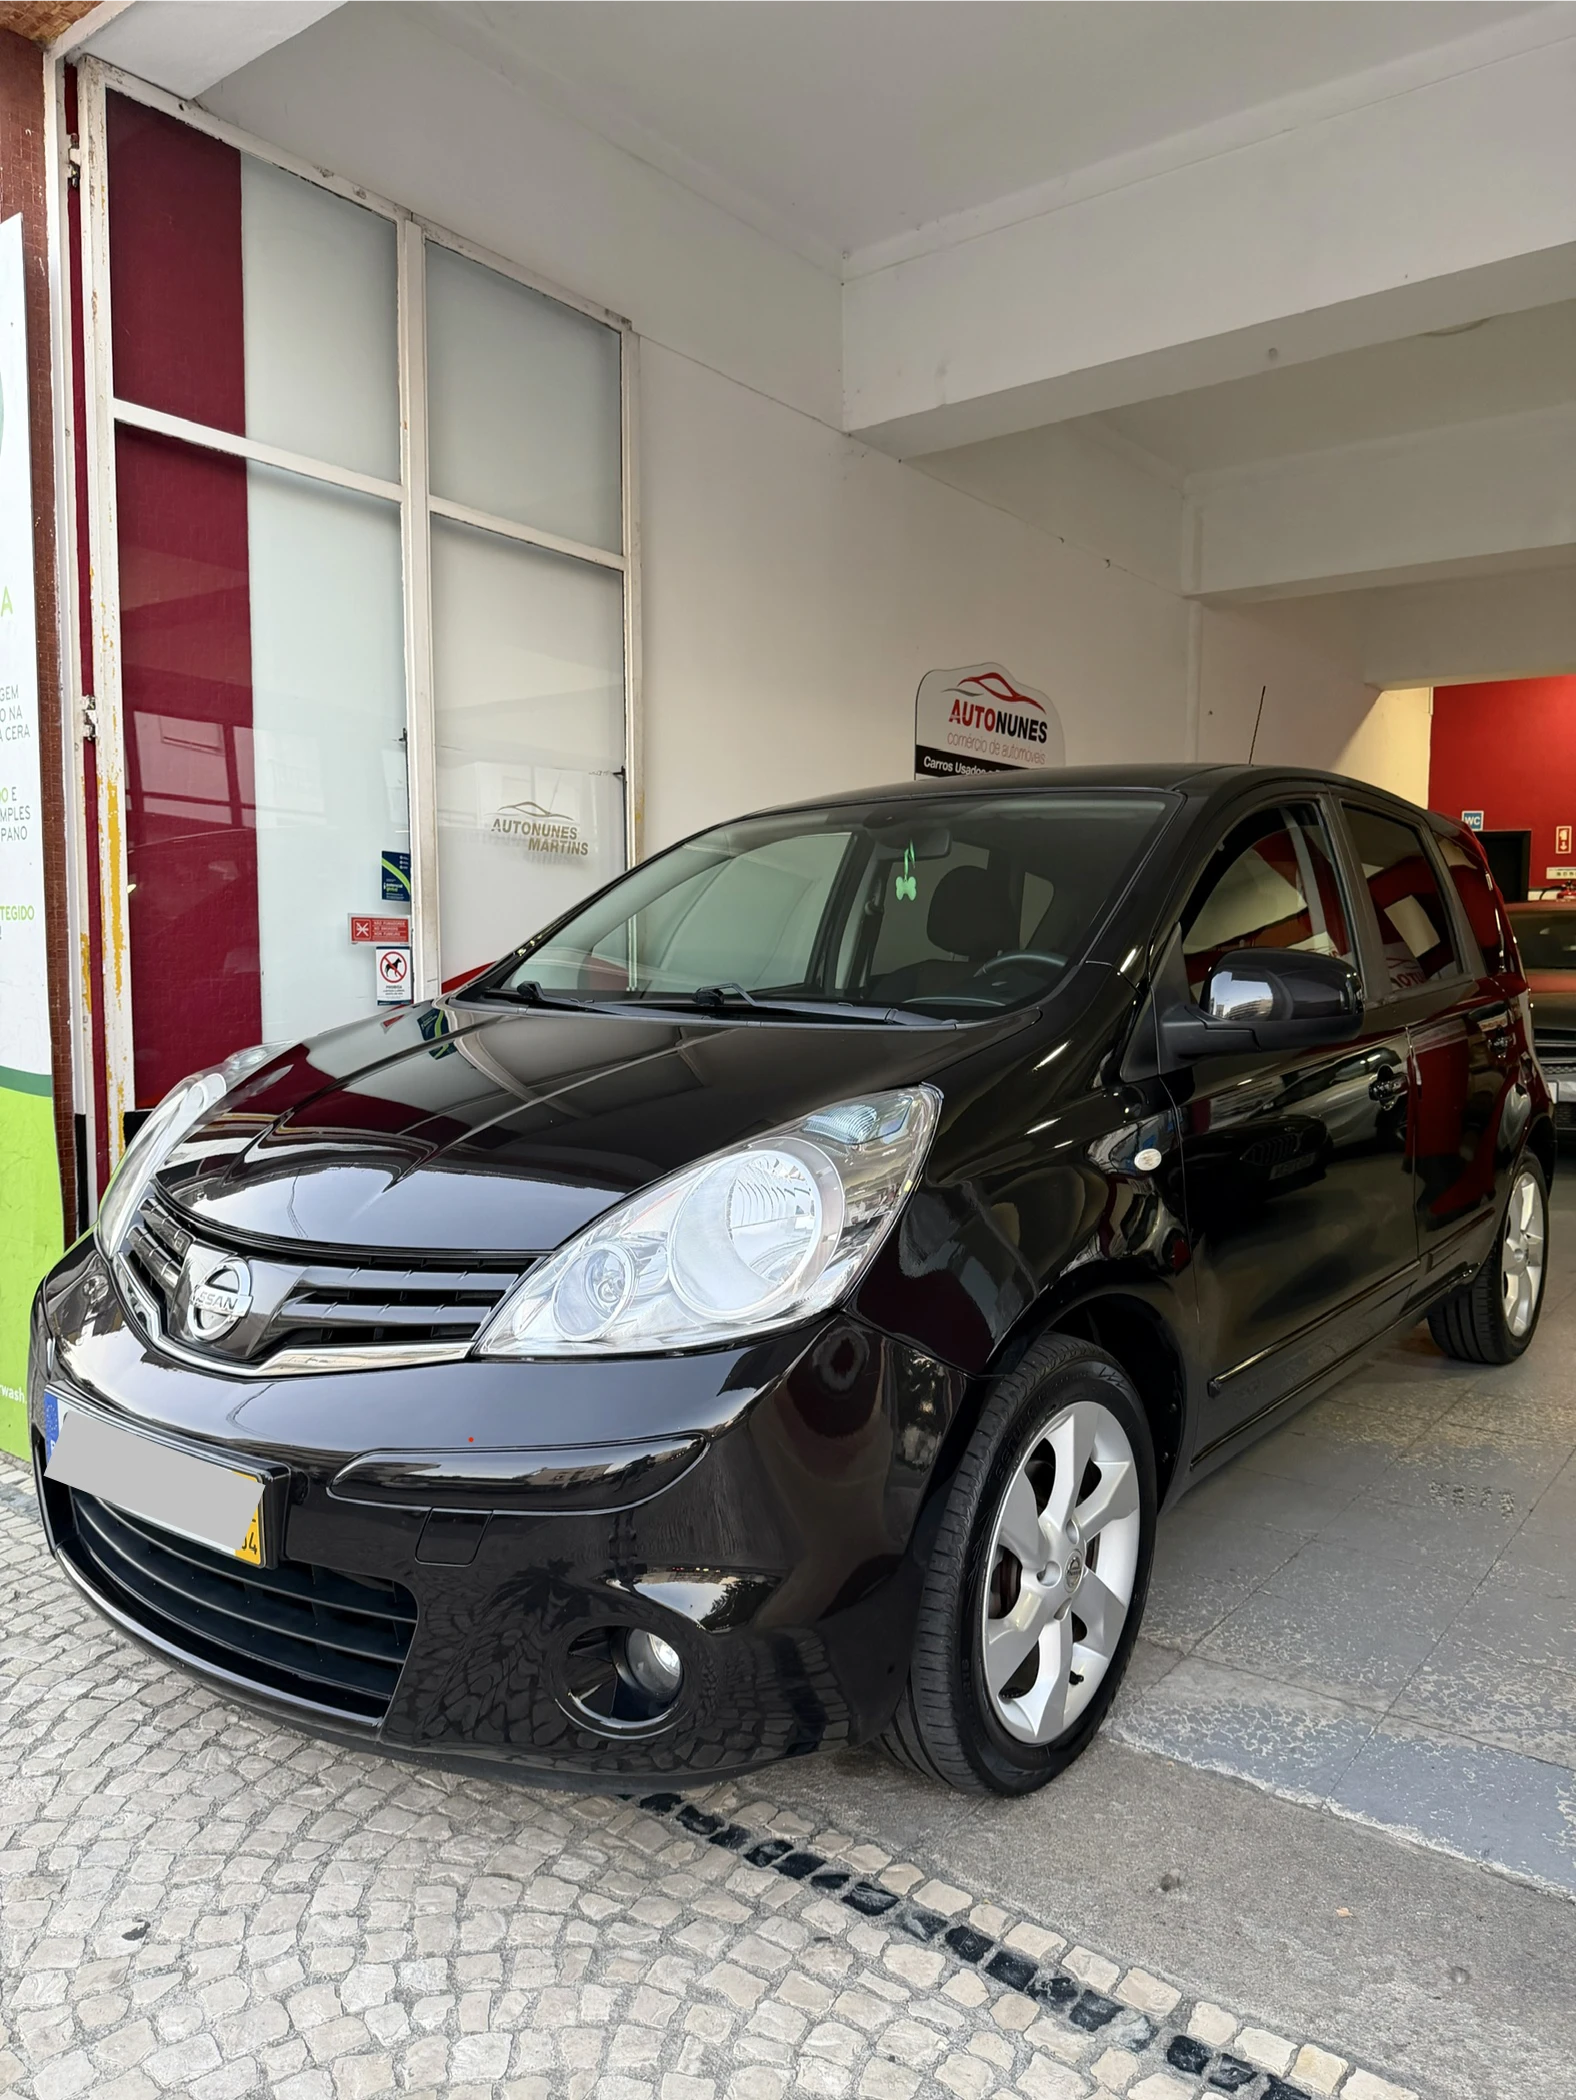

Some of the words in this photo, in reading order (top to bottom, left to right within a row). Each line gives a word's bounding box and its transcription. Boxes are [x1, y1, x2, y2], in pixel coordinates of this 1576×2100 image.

[9, 705, 23, 721] NA
[948, 698, 1048, 744] AUTONUNES
[5, 724, 31, 741] CERA
[947, 732, 987, 753] comércio
[989, 739, 1000, 756] de
[923, 755, 954, 772] Carros
[11, 786, 17, 801] E
[491, 818, 578, 841] AUTONUNES
[1464, 816, 1481, 826] WC
[1, 825, 28, 842] PANO
[528, 837, 589, 856] MARTINS
[0, 904, 35, 921] TEGIDO
